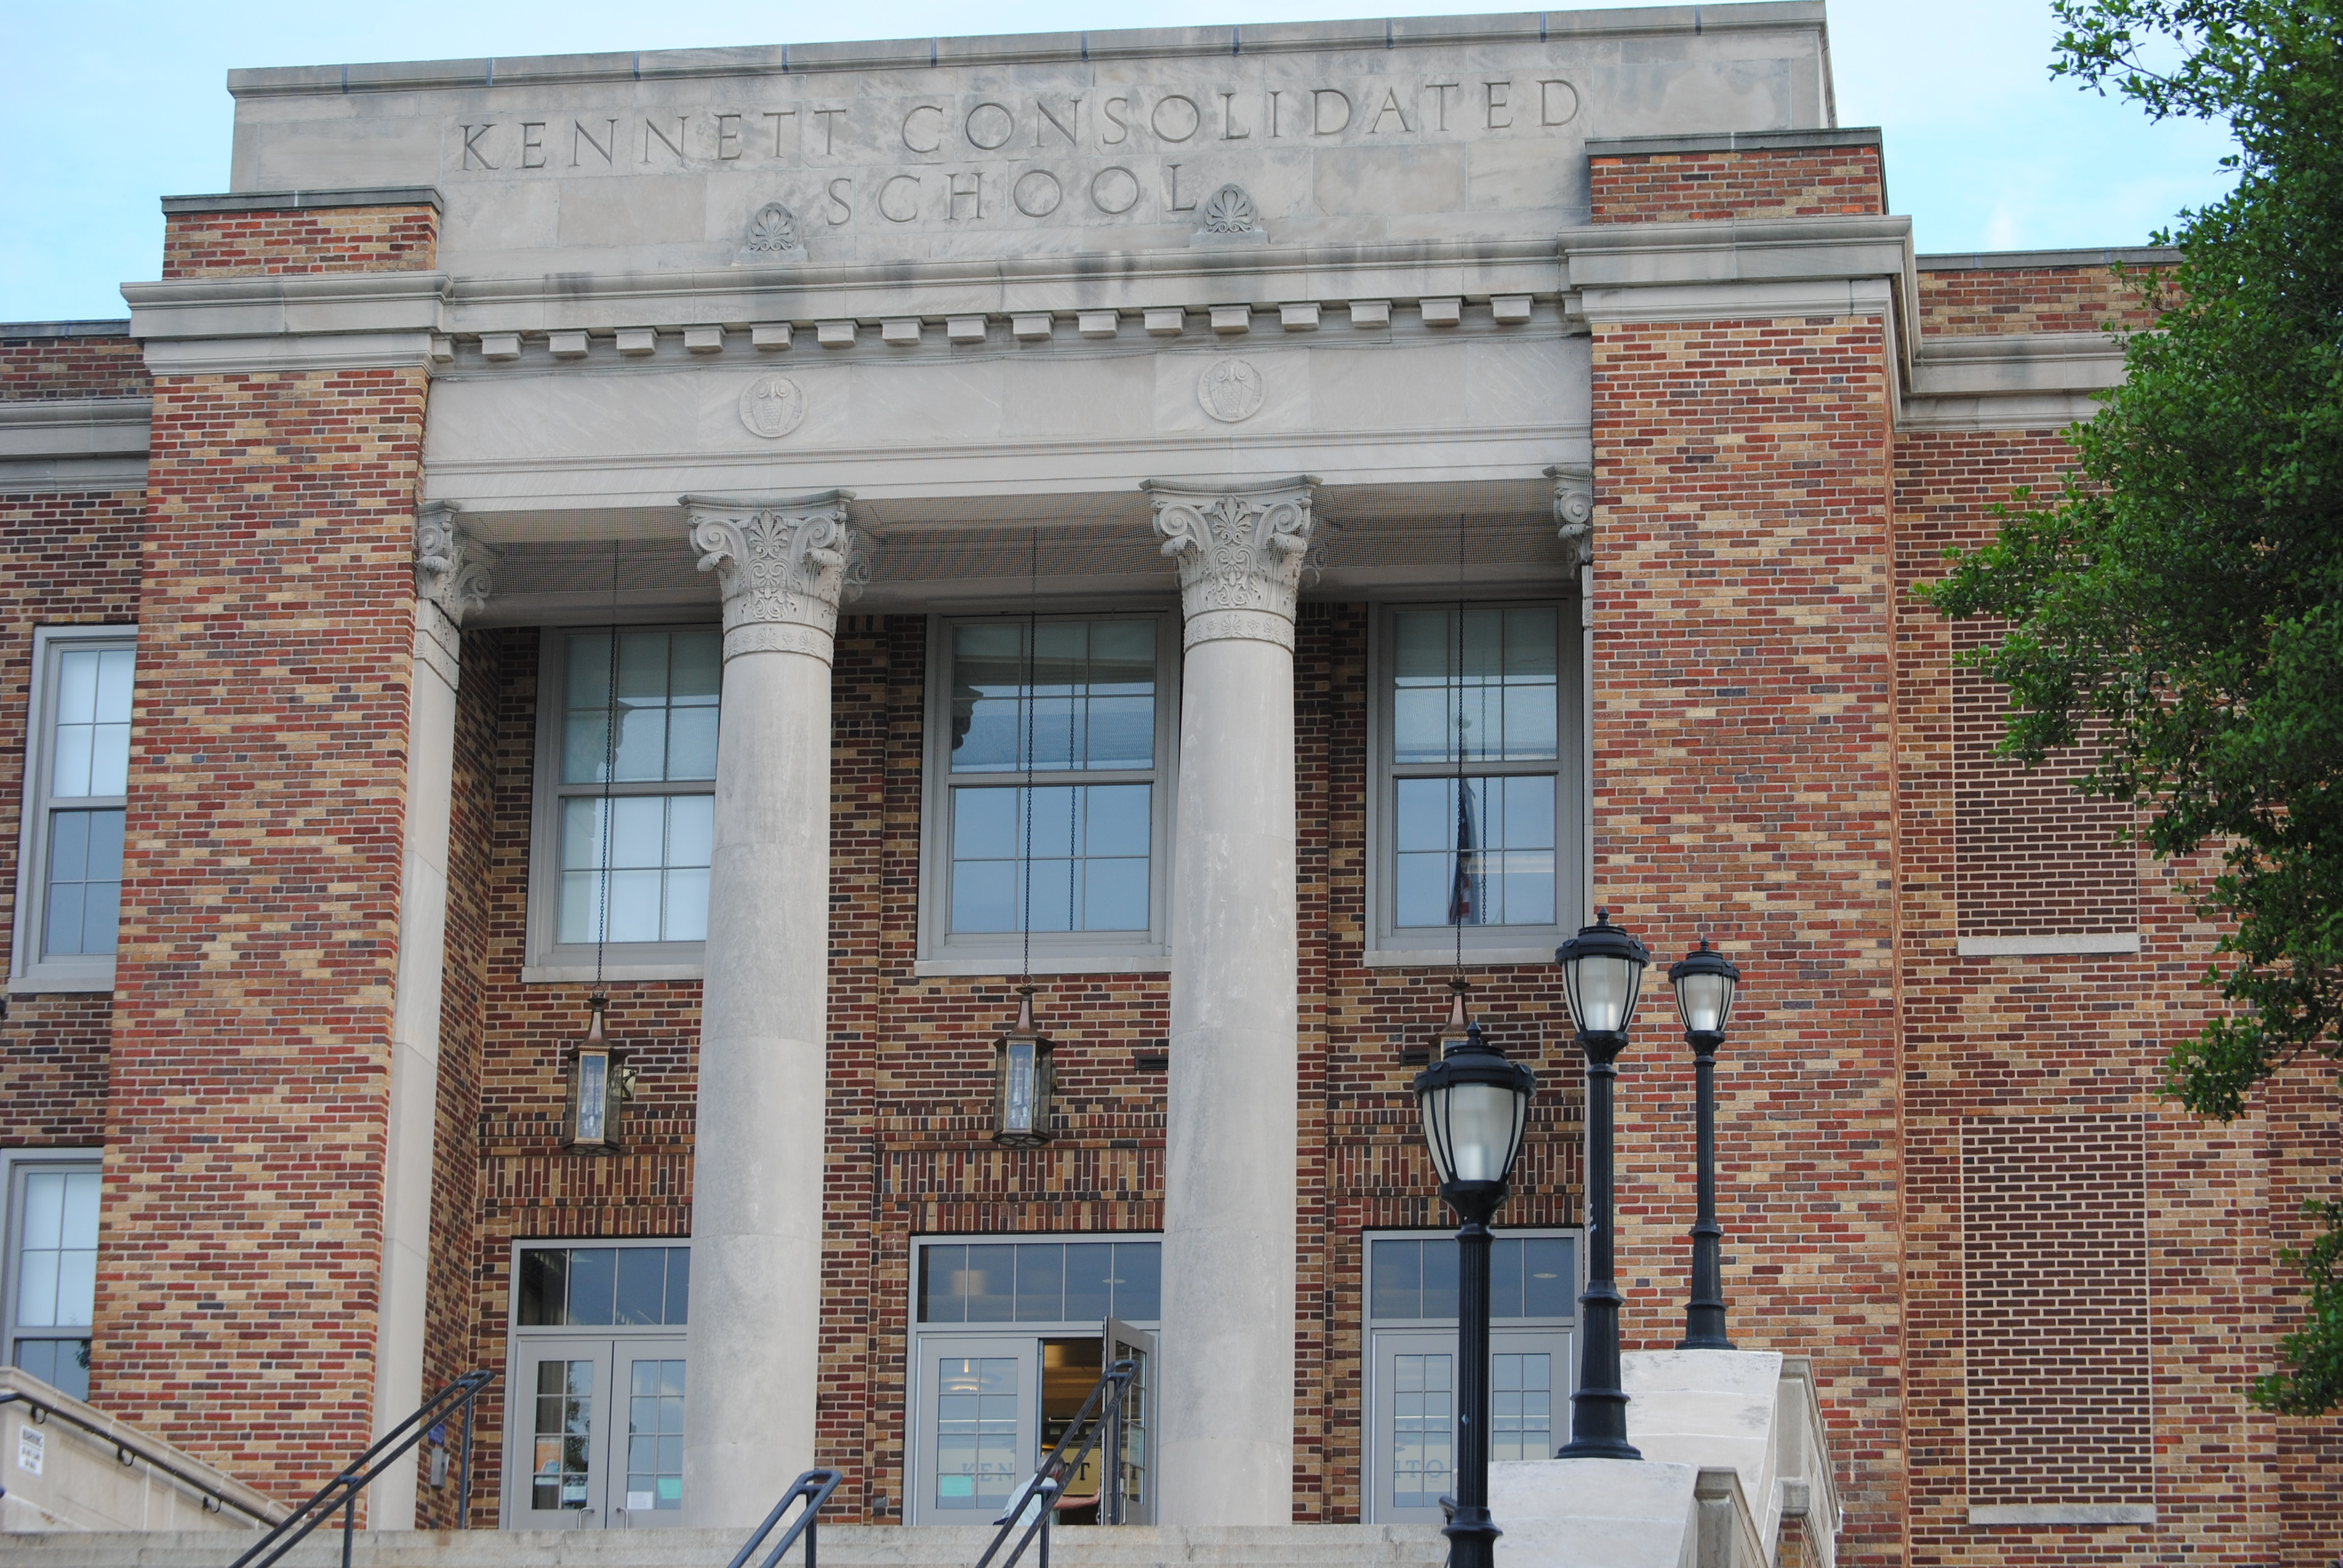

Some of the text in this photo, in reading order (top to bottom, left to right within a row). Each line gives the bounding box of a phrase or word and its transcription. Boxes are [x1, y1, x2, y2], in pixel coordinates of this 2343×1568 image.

[455, 79, 1580, 172] KENNETT CONSOLIDATED
[826, 164, 1198, 226] SCHOOL
